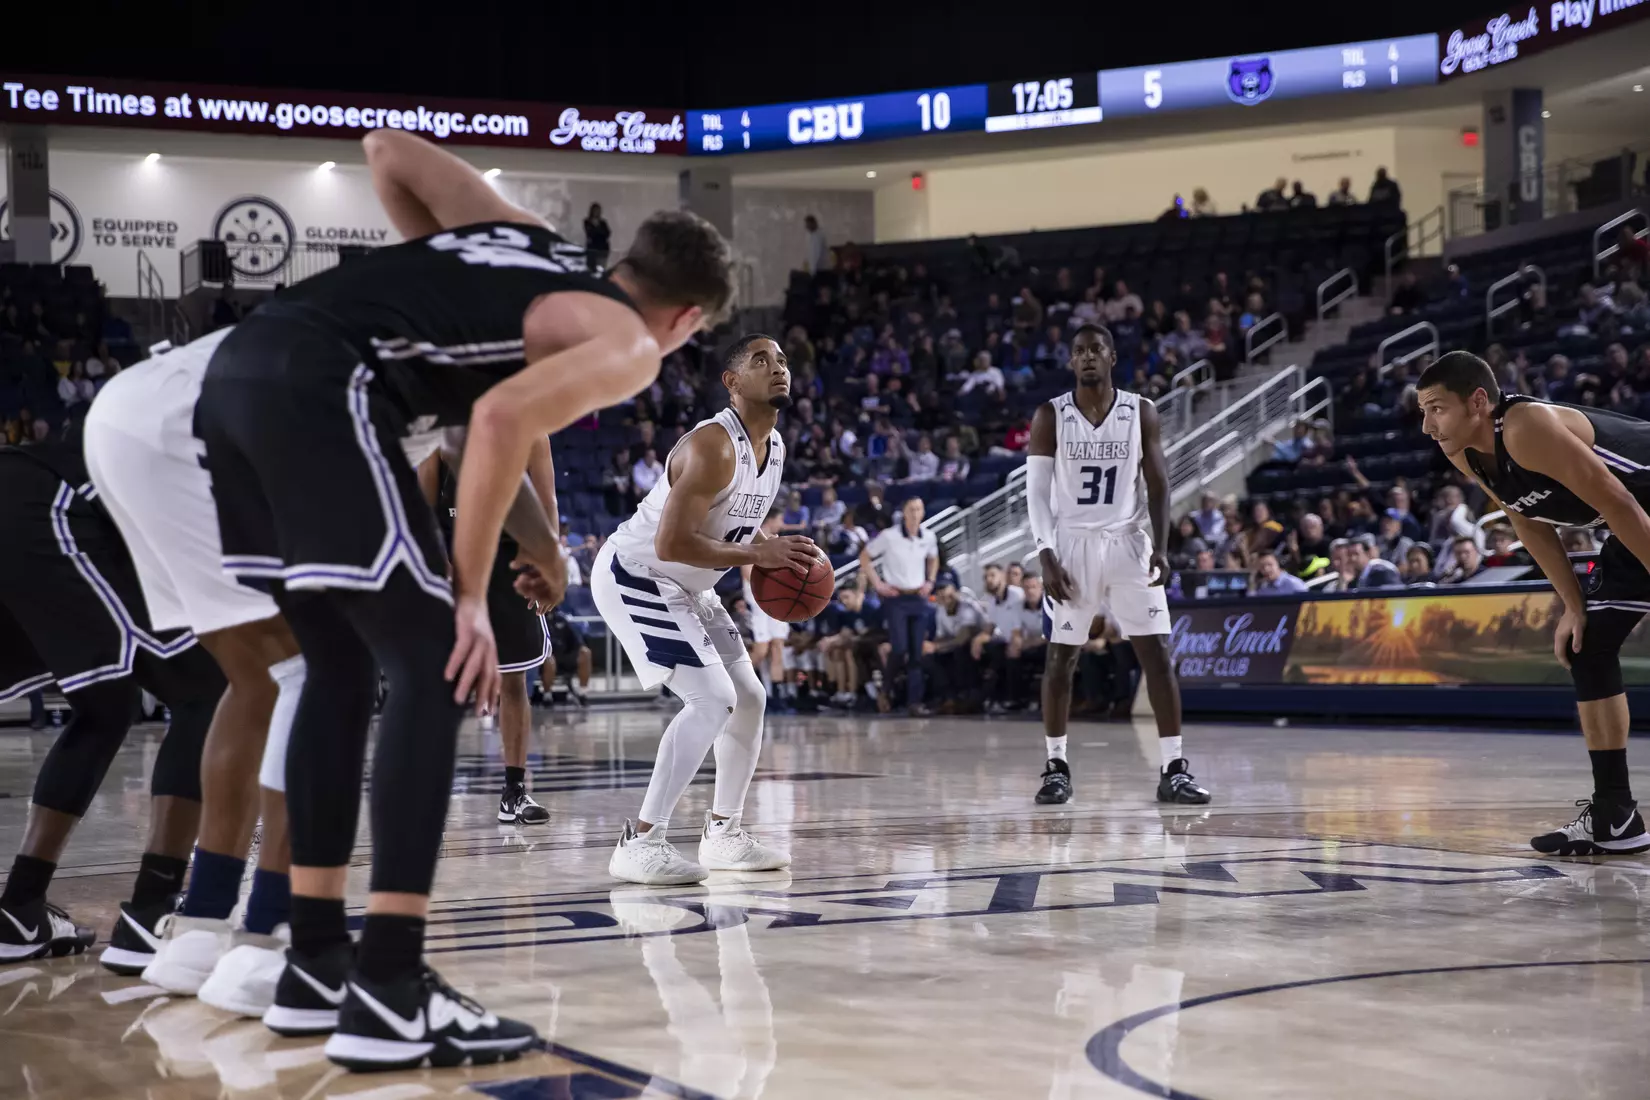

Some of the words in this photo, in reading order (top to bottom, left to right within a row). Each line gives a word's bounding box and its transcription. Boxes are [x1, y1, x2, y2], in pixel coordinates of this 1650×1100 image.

[1550, 0, 1595, 31] Play
[1387, 43, 1399, 62] 4
[1440, 29, 1490, 75] Goose
[1486, 6, 1539, 48] Creek
[1388, 65, 1398, 84] 1
[1012, 78, 1073, 113] 17:05
[1143, 70, 1162, 109] 5
[3, 82, 59, 110] Tee
[66, 86, 156, 116] Times
[164, 93, 192, 118] at
[198, 98, 529, 138] www.goosecreekgc.com
[740, 110, 750, 128] 4
[787, 102, 864, 144] CBU
[916, 92, 950, 132] 10
[549, 108, 618, 145] Goose
[615, 111, 684, 141] Creek
[581, 136, 618, 151] GOLF
[619, 137, 655, 153] CLUB
[742, 131, 750, 149] 1
[92, 218, 178, 234] EQUIPPED
[306, 226, 388, 241] GLOBALLY
[94, 233, 117, 247] TO
[121, 235, 176, 249] SERVE
[1066, 441, 1129, 460] LANCERS
[1077, 465, 1118, 505] 31
[1224, 612, 1288, 656] Creek
[1179, 657, 1213, 678] GOLF
[1213, 657, 1250, 677] CLUB
